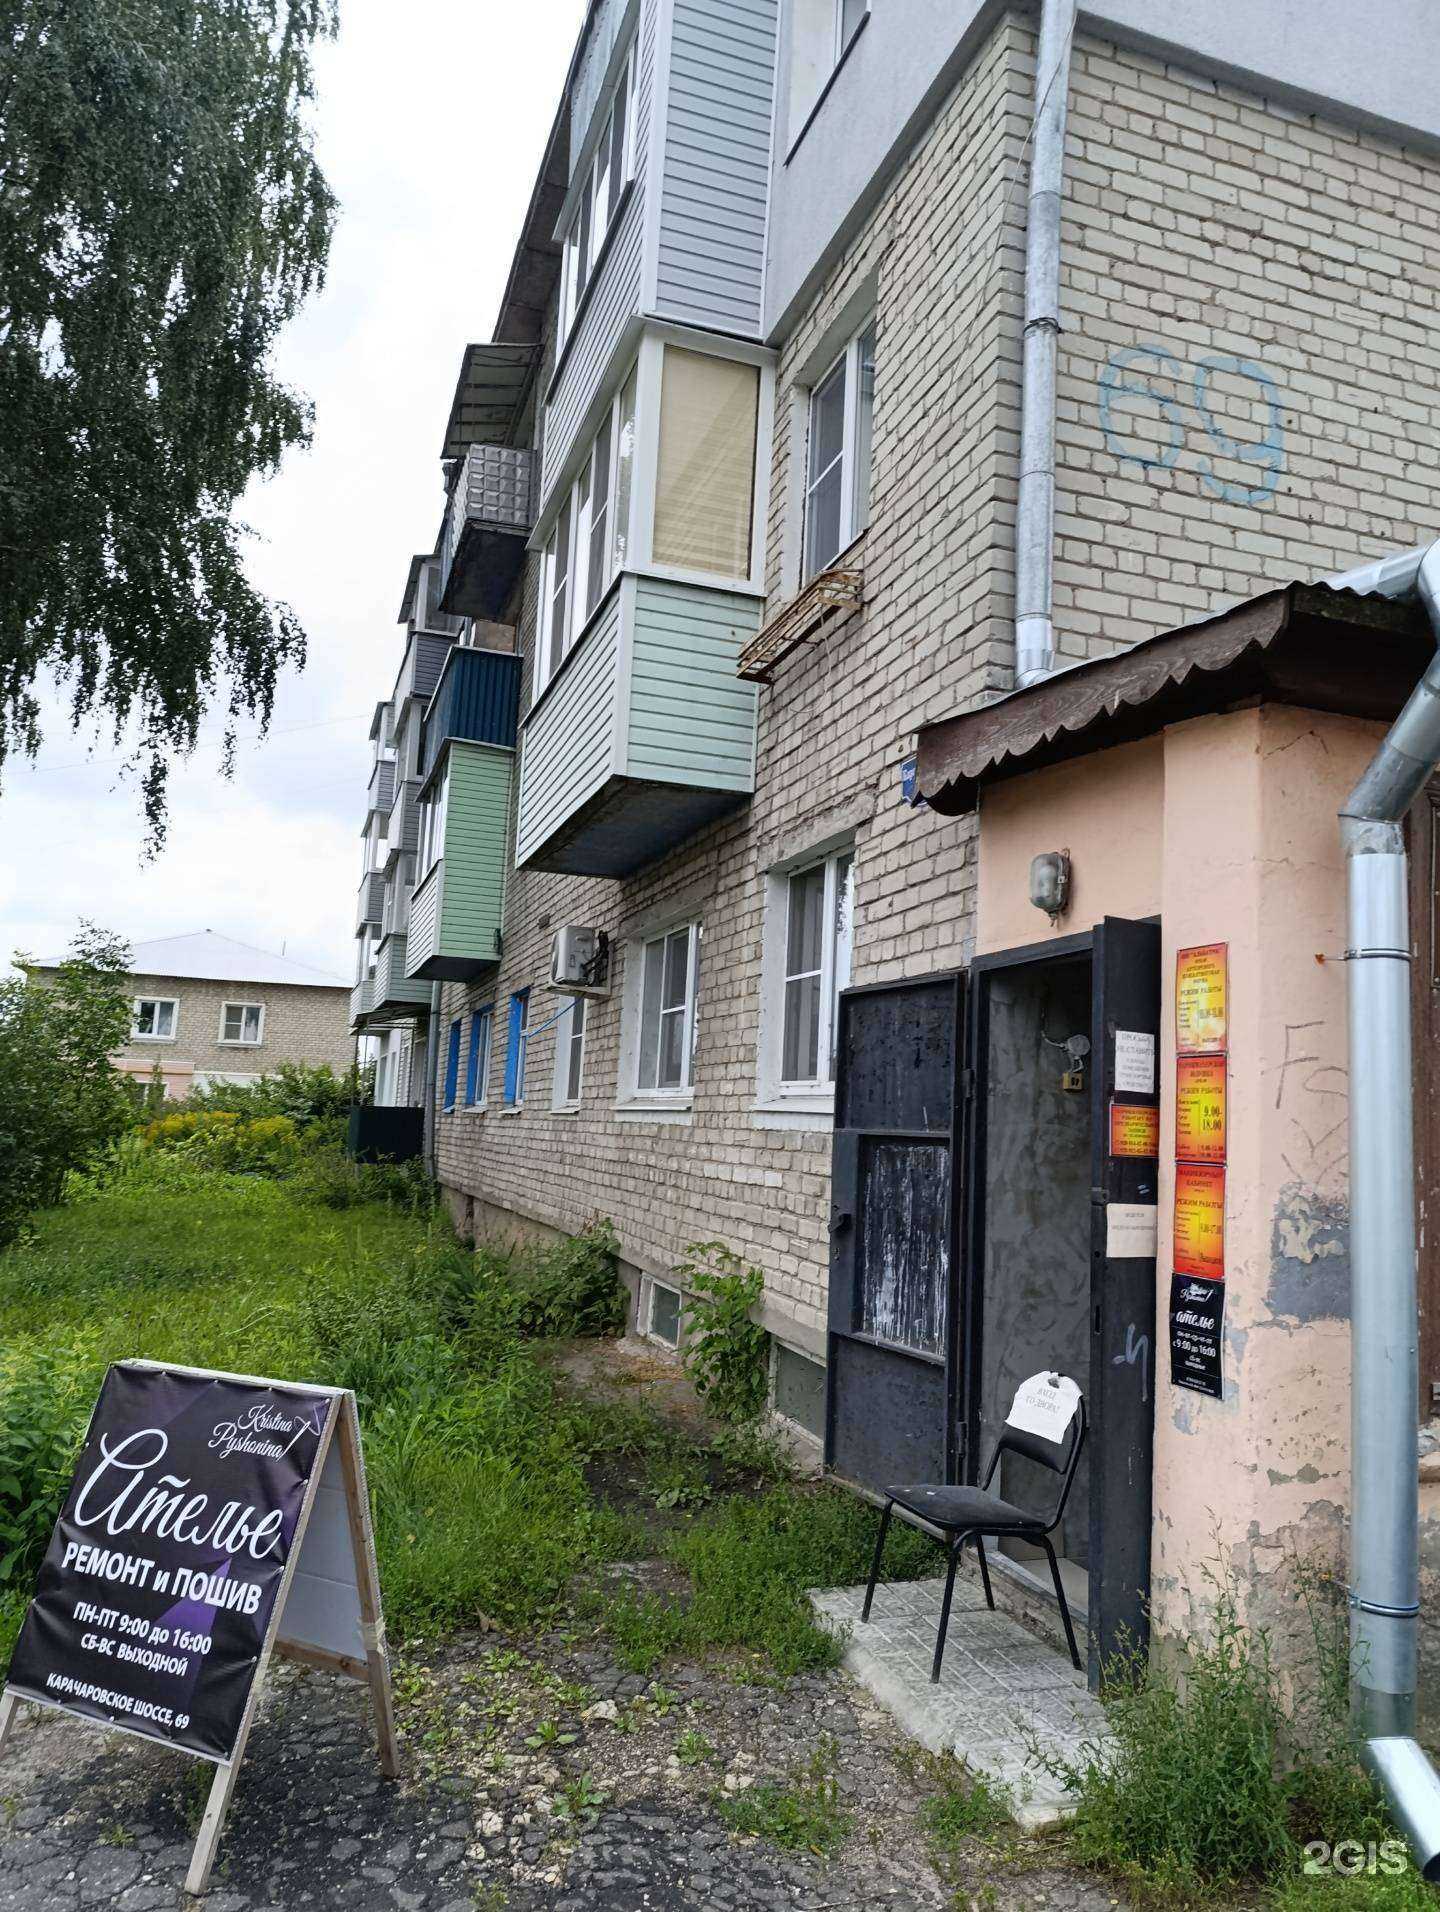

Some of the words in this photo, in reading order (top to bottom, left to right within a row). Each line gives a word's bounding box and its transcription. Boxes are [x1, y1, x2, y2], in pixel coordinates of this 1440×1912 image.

[1098, 343, 1284, 504] 69
[237, 1404, 293, 1433] Kristina
[73, 1429, 285, 1559] Ателье
[61, 1542, 155, 1588] РЕМОНТ
[152, 1569, 171, 1593] и
[171, 1567, 263, 1615] ПОШИВ
[73, 1601, 120, 1629] ПН-ПТ
[118, 1614, 150, 1638] 9:00
[149, 1629, 170, 1646] до
[172, 1628, 212, 1655] 16:00
[80, 1633, 117, 1656] СБ-ВС
[116, 1642, 189, 1677] ВЫХОДНОЙ
[46, 1672, 134, 1712] КАРАЧАРОВСКОЕ
[132, 1699, 173, 1726] ШОССЕ,
[174, 1713, 190, 1729] 69
